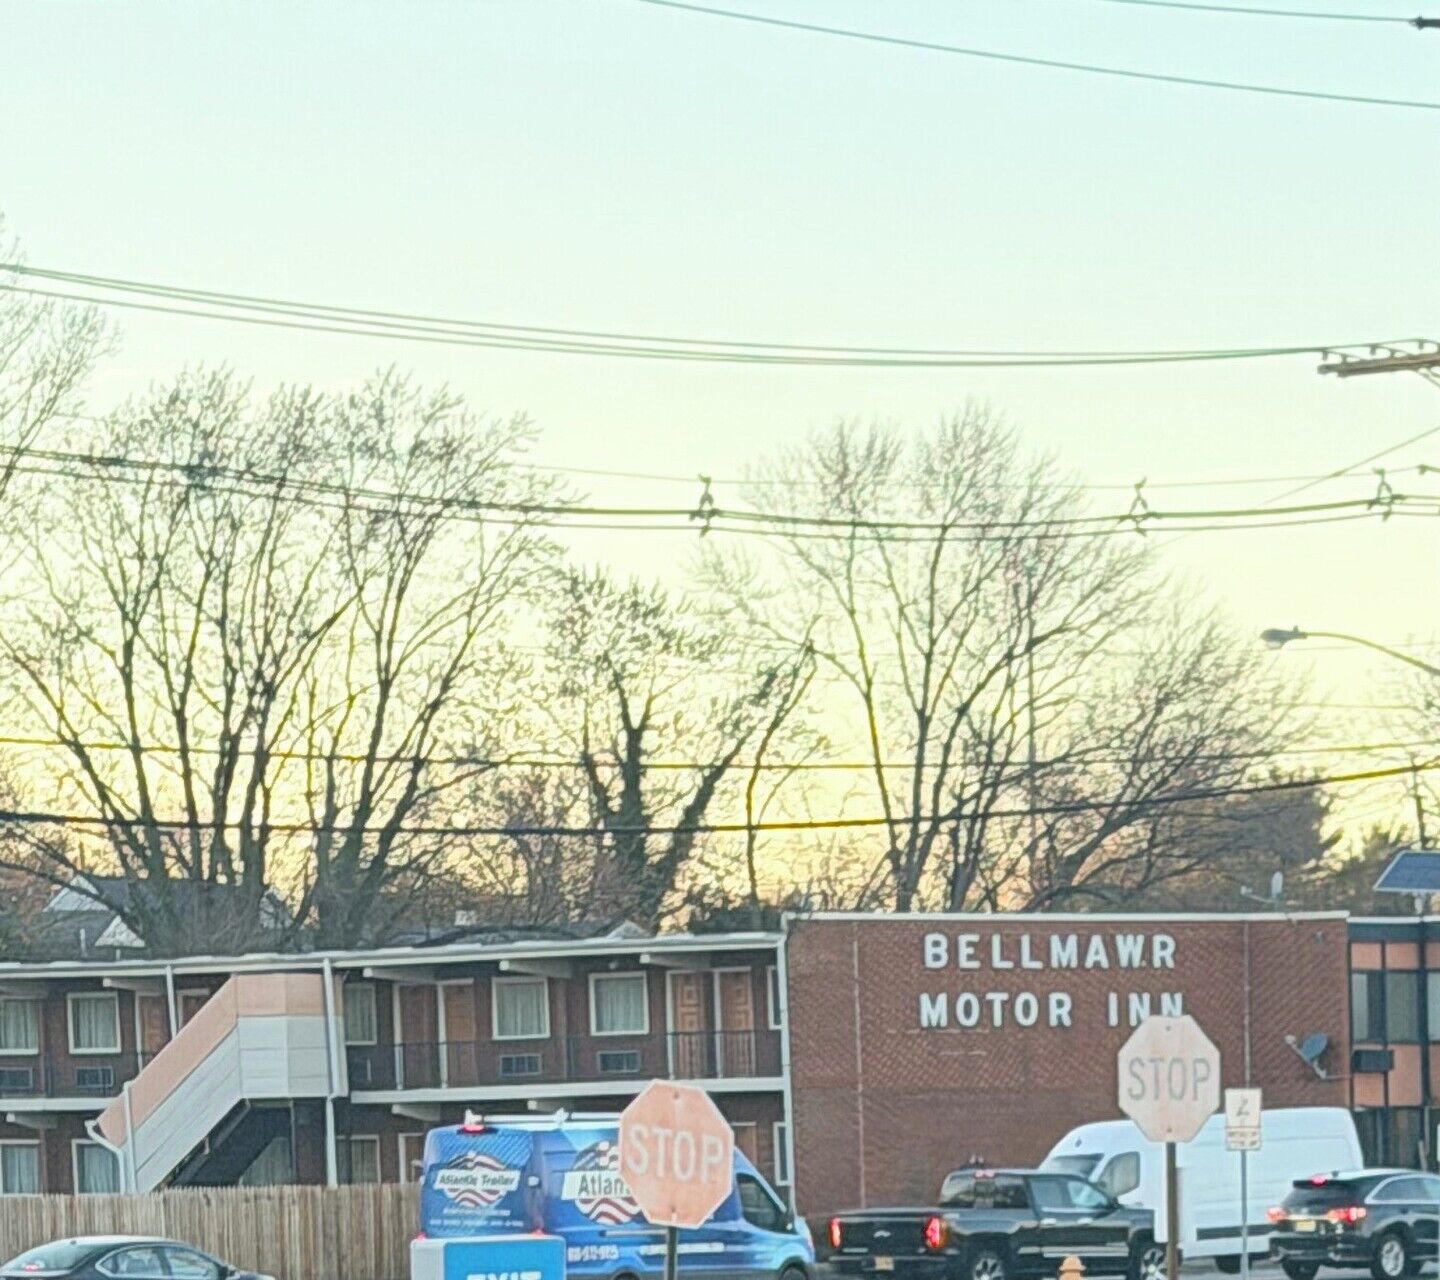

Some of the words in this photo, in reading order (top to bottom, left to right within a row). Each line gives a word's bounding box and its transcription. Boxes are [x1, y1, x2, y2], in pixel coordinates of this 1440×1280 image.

[924, 933, 1176, 968] BELLMAWR
[919, 992, 1072, 1027] MOTOR
[1108, 992, 1183, 1027] INN
[1128, 1057, 1210, 1101] STOP
[624, 1123, 725, 1184] STOP
[578, 1174, 632, 1196] Atlan
